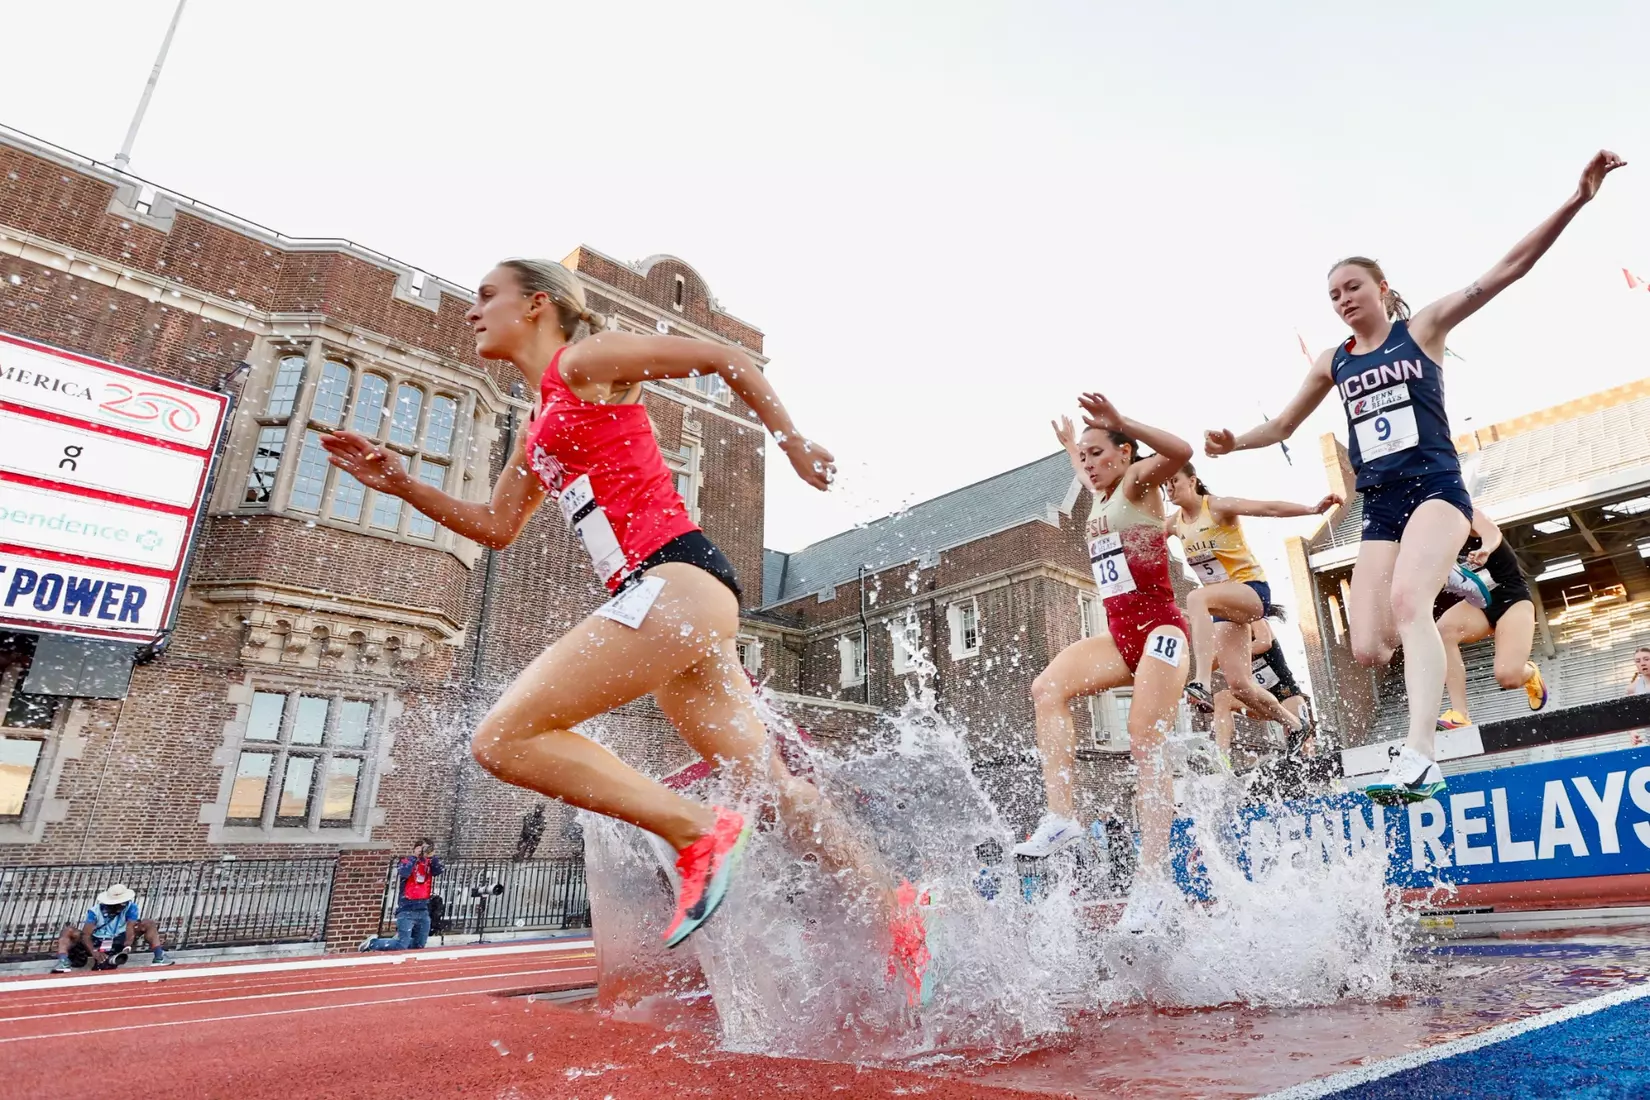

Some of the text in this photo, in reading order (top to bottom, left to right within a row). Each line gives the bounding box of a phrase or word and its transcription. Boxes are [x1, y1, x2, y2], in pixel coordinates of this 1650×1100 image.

[1371, 390, 1393, 402] PENN
[98, 383, 201, 433] 250
[1375, 417, 1391, 441] 9
[1099, 560, 1118, 584] 18
[1203, 563, 1214, 575] 5
[4, 567, 147, 624] POWER
[1154, 635, 1177, 658] 18
[1255, 673, 1265, 684] 8
